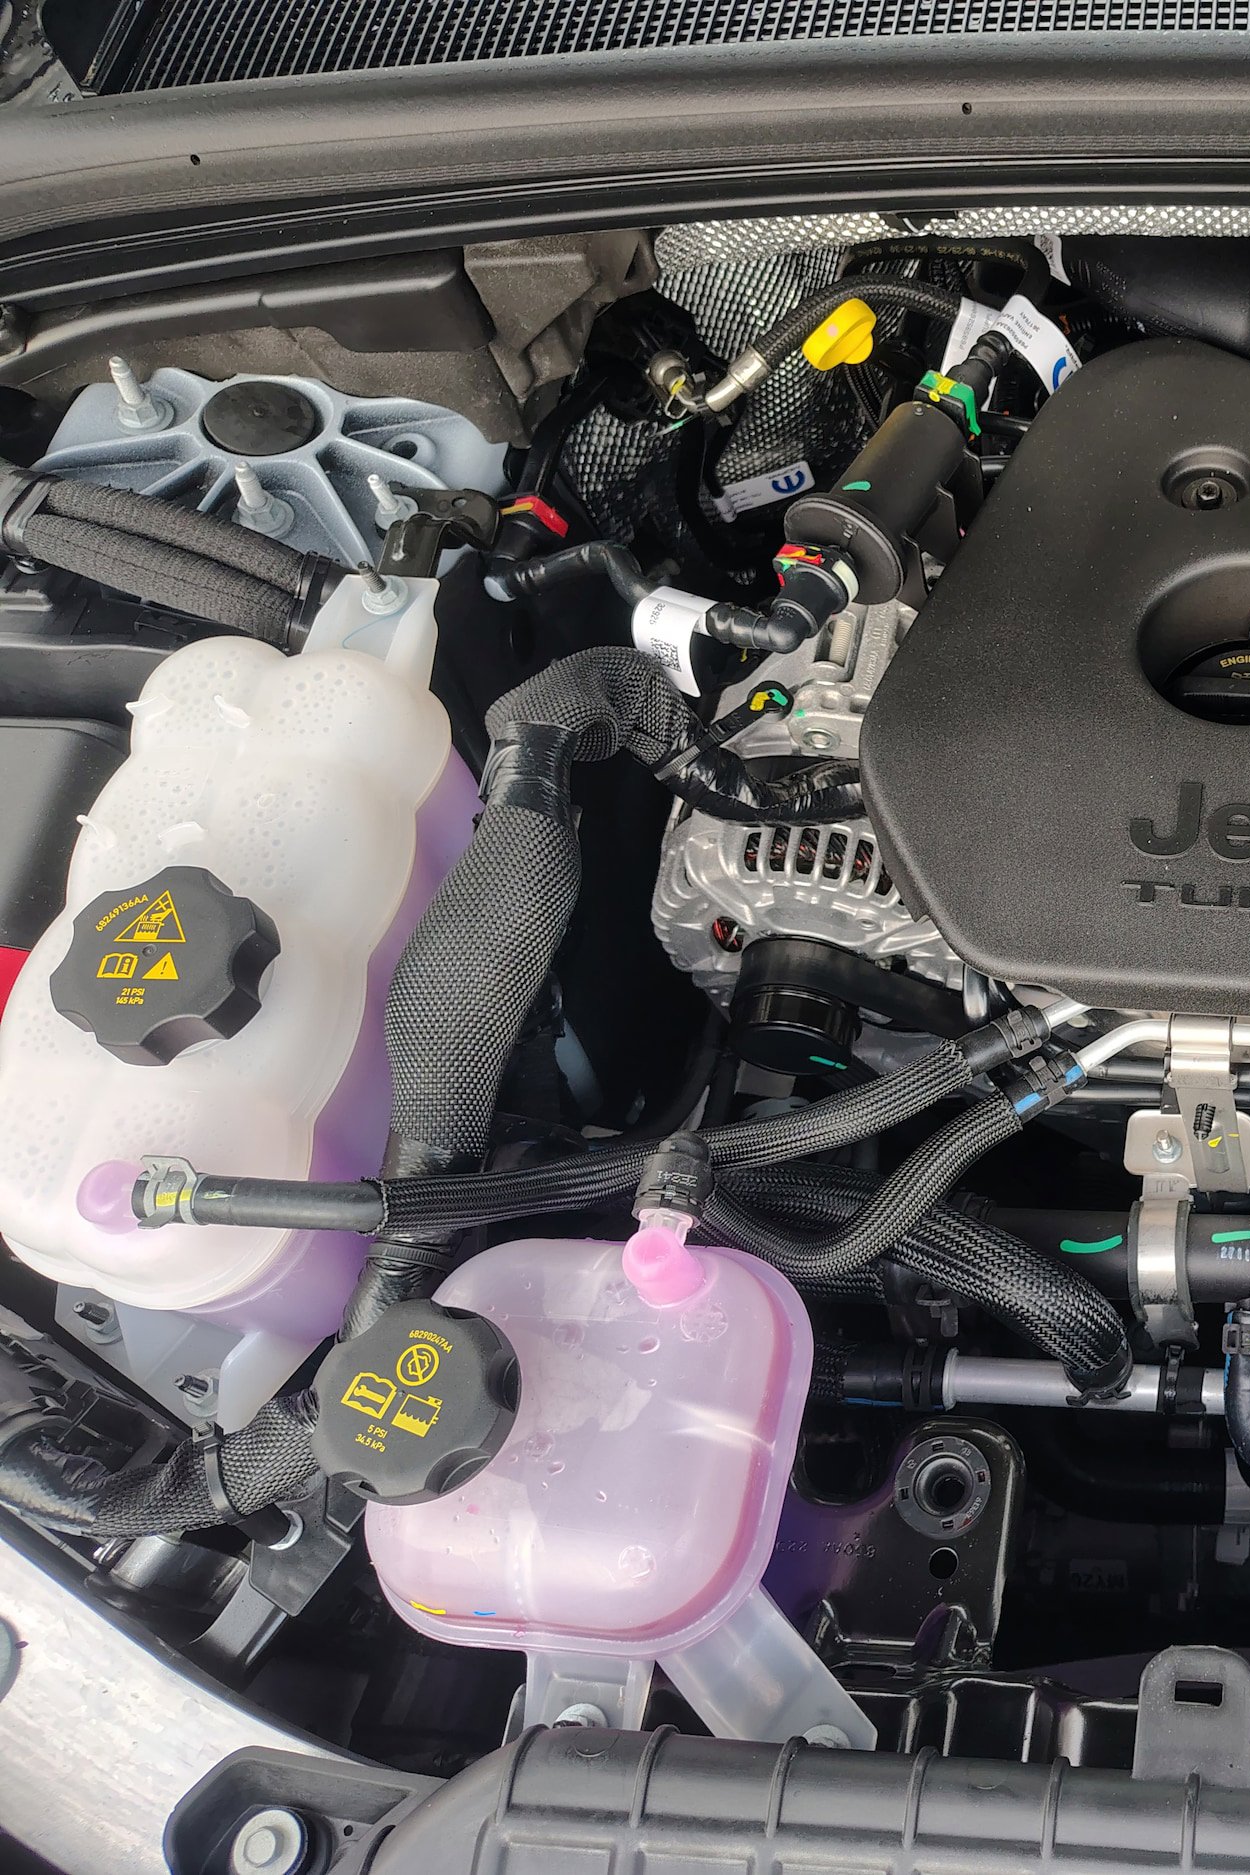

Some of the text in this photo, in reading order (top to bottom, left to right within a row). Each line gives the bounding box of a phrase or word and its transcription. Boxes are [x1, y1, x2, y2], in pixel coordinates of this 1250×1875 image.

[95, 893, 149, 932] 68249136AA
[121, 987, 146, 997] 21 PSI
[115, 996, 144, 1006] 145 kPa
[408, 1329, 453, 1354] 68290247AA
[367, 1424, 388, 1439] 5 PSI
[355, 1433, 386, 1453] 34.5 kPa
